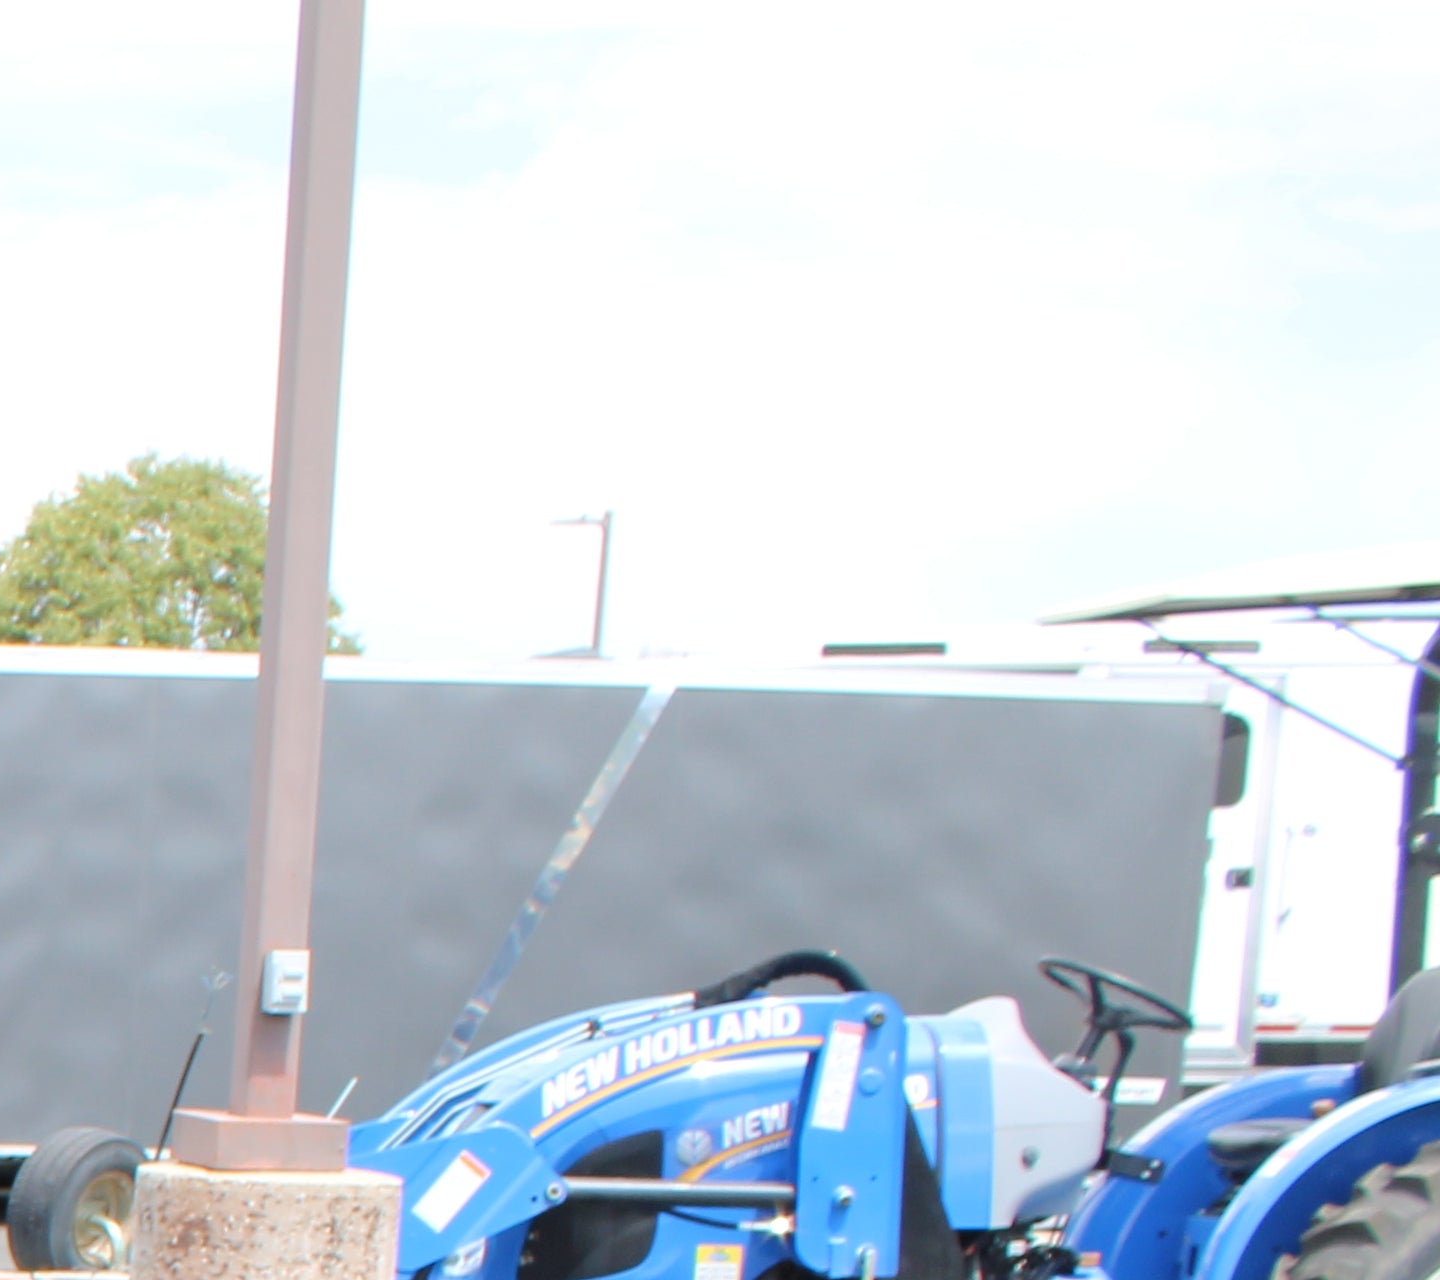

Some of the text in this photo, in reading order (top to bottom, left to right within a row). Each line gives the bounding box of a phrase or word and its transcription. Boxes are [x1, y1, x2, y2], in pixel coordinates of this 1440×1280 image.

[541, 1004, 802, 1119] NEW HOLLAND
[722, 1101, 791, 1149] NEW
